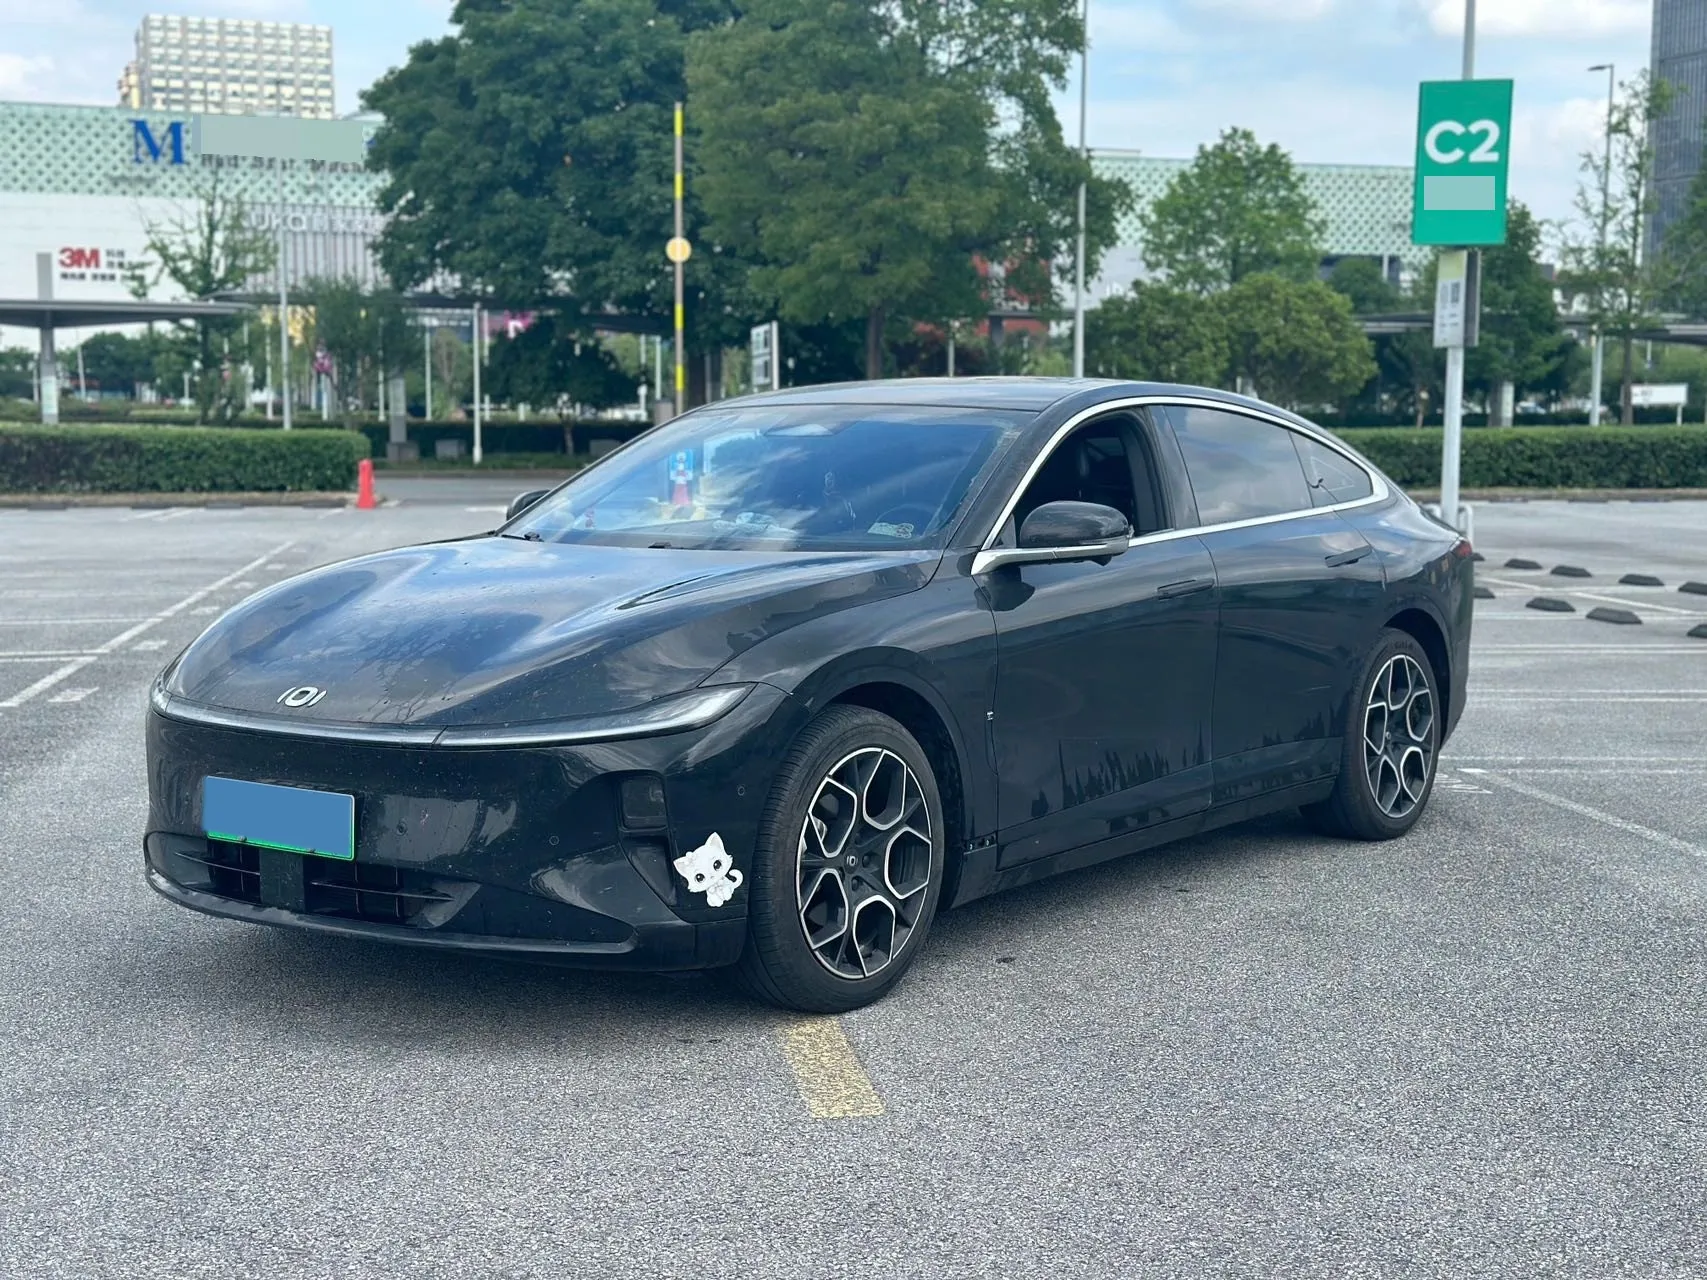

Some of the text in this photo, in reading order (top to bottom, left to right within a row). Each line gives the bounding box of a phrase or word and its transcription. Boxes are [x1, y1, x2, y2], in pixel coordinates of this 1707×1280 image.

[129, 118, 186, 165] M
[1424, 119, 1500, 164] C2
[59, 247, 100, 269] 3M
